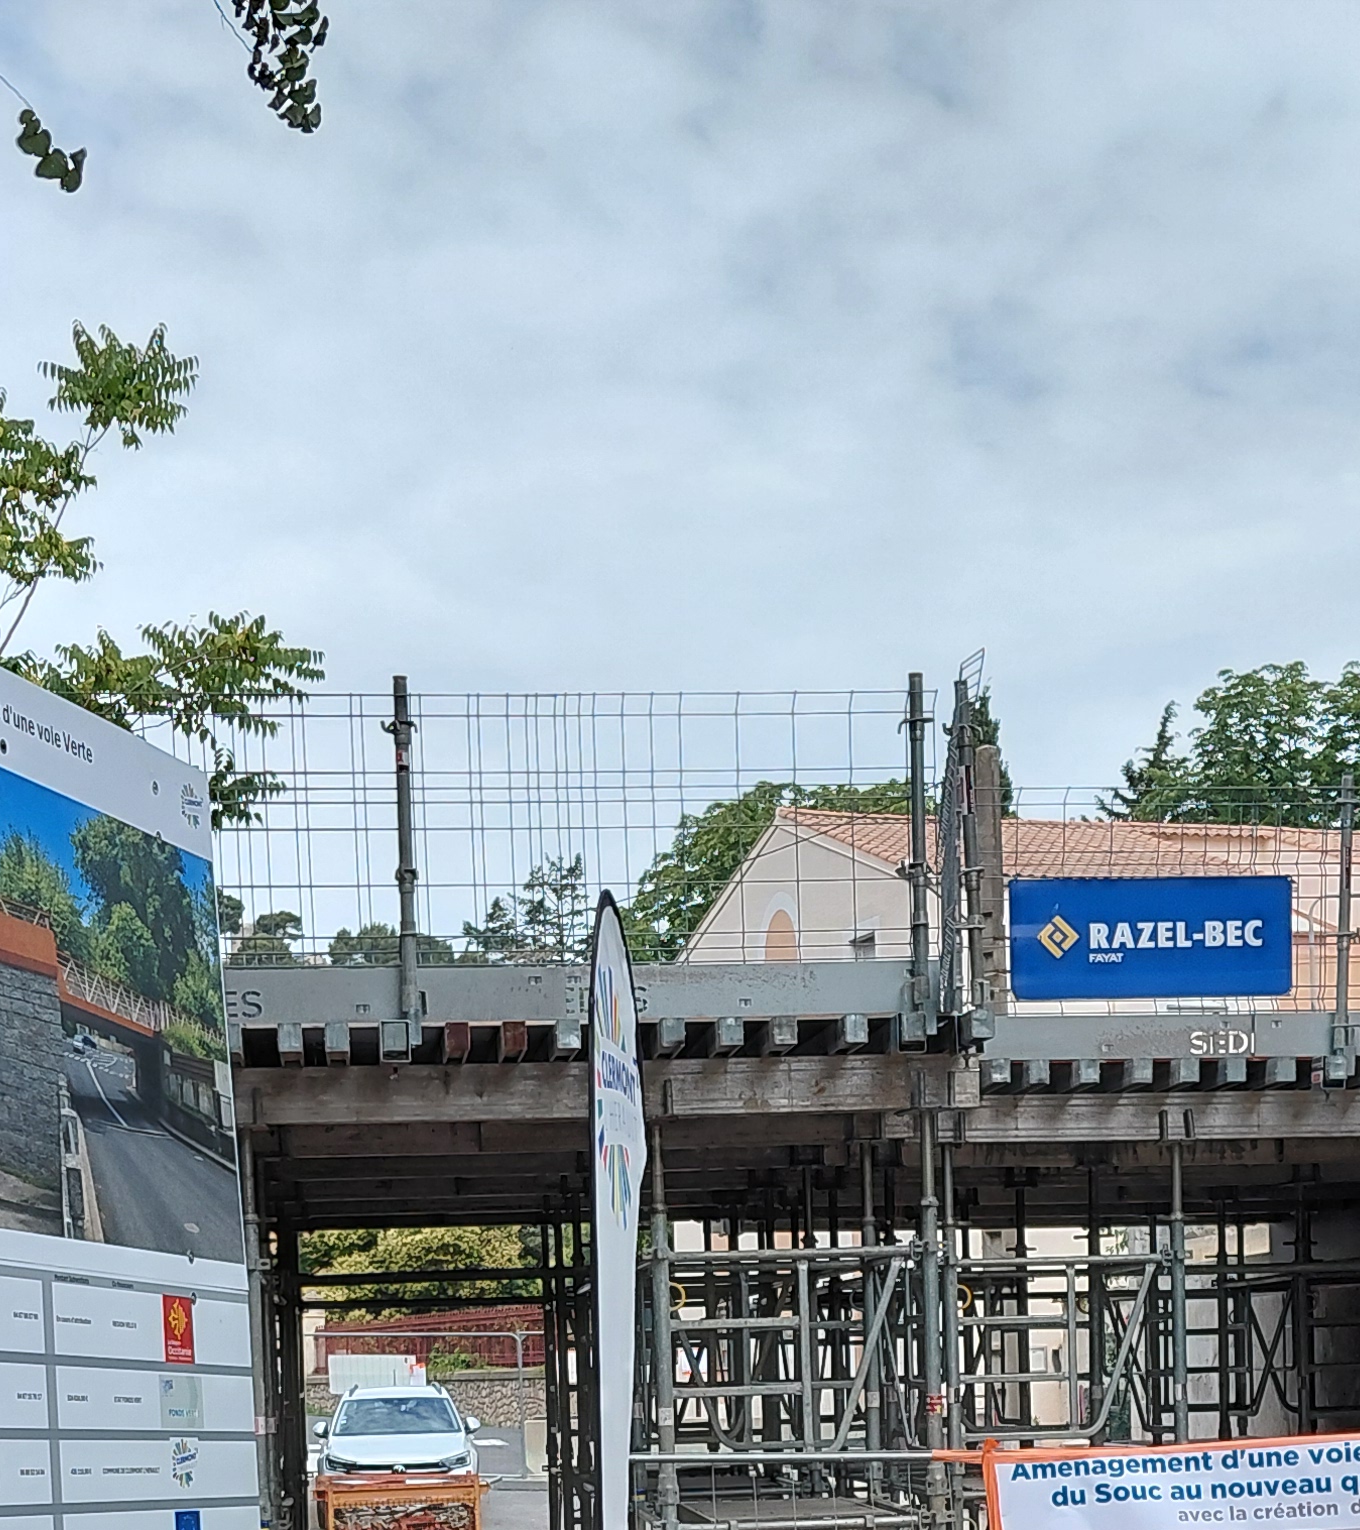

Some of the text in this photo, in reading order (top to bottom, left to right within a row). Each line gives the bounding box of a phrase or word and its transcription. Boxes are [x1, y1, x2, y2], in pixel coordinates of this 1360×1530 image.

[2, 704, 35, 736] d'une
[37, 723, 64, 748] voie
[62, 731, 93, 764] Verte
[1089, 919, 1263, 950] RAZEL-BEC
[1089, 952, 1124, 963] FAYAT
[601, 1050, 637, 1106] CLERMONT
[1221, 1448, 1300, 1470] d'une
[1051, 1485, 1087, 1507] du
[1094, 1482, 1162, 1504] Souc
[1170, 1483, 1202, 1501] au
[1210, 1474, 1333, 1499] nouveau
[1178, 1507, 1224, 1522] avec
[1229, 1505, 1248, 1521] la
[1253, 1498, 1339, 1520] création
